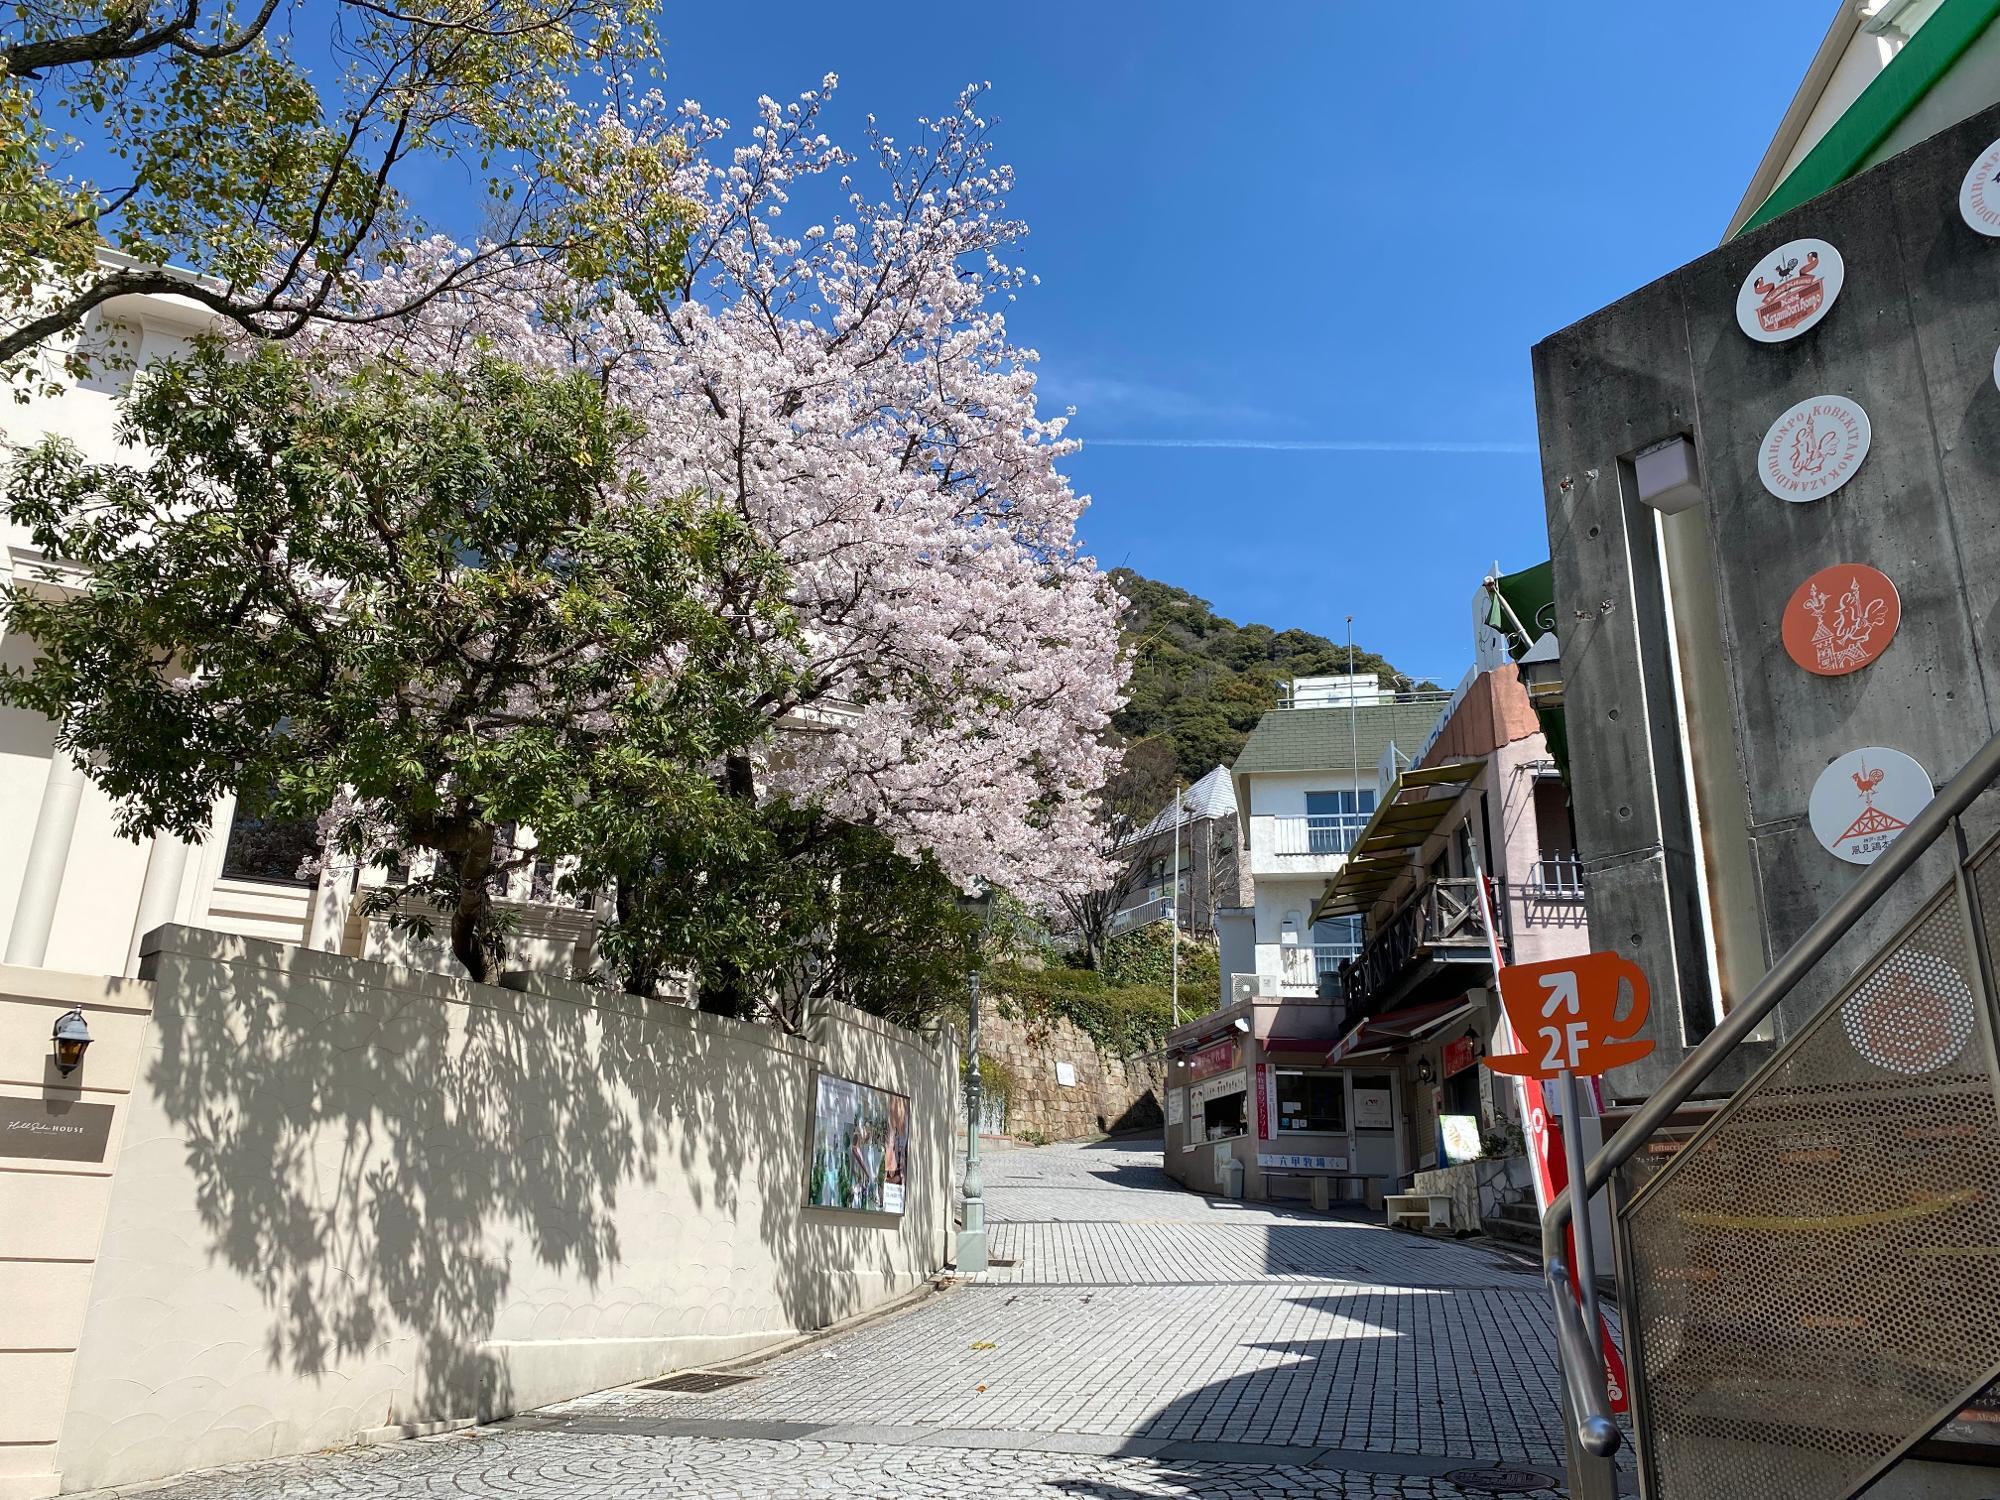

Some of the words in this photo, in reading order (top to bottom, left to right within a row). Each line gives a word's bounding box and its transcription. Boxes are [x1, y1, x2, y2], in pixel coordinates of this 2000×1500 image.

[1540, 1022, 1589, 1070] 2F
[52, 1125, 84, 1134] HOUSE
[1279, 1155, 1325, 1168] 六甲牧場
